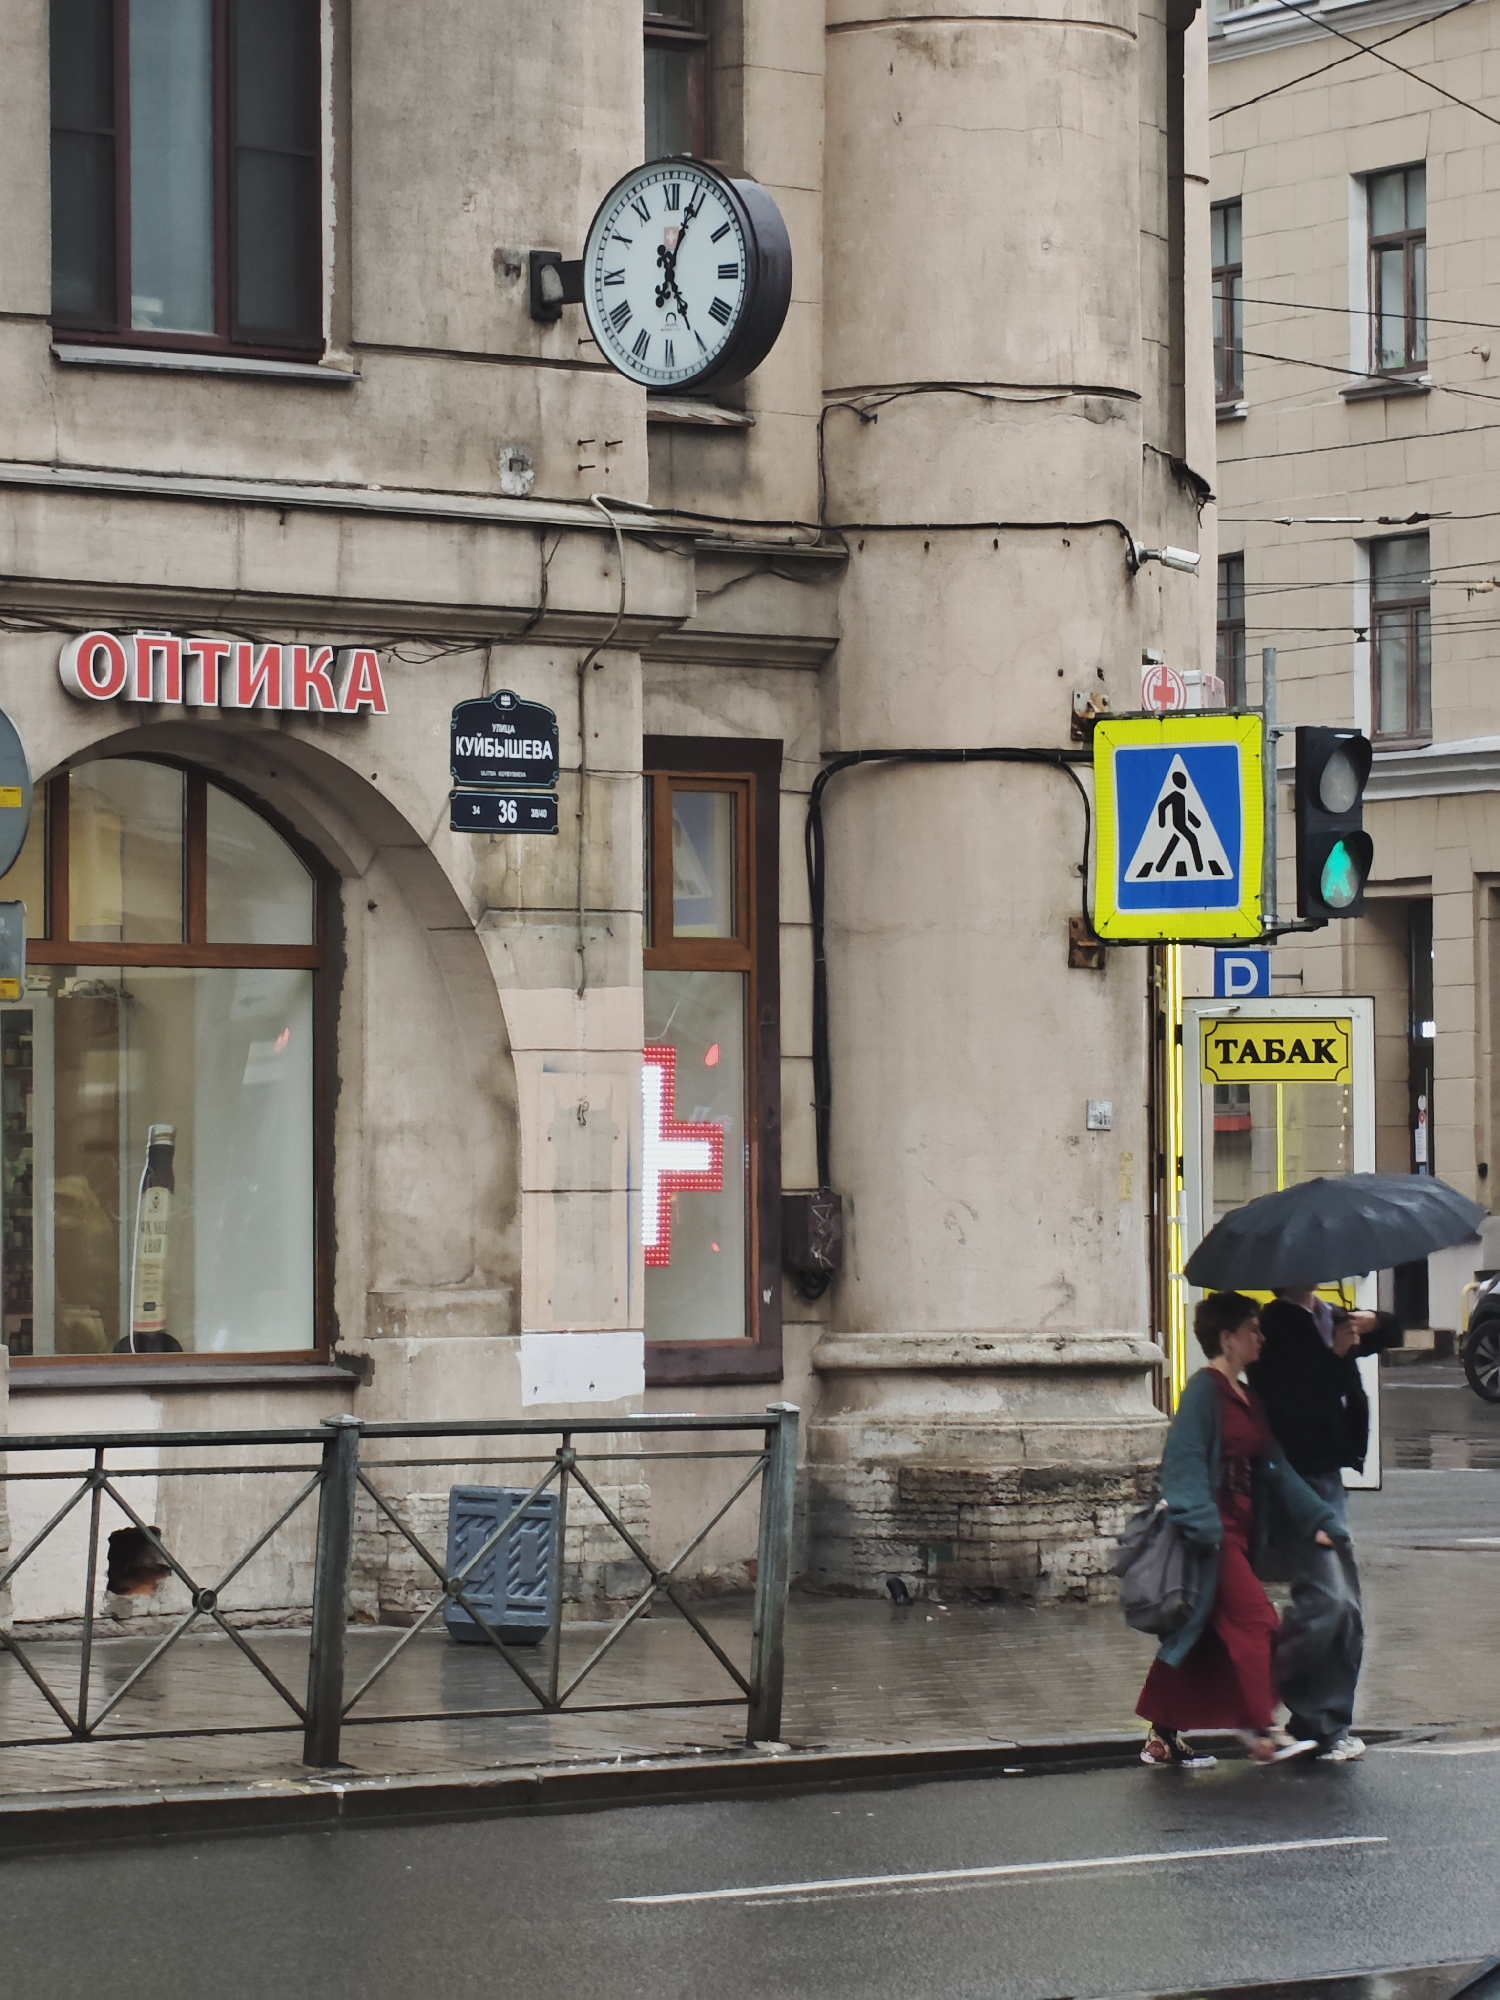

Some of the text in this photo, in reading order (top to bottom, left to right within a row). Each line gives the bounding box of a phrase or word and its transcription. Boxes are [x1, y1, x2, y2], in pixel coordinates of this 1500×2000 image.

[663, 183, 681, 211] XII
[611, 228, 633, 250] X
[710, 221, 731, 244] II
[717, 263, 739, 279] III
[72, 630, 390, 715] ОПТИКА
[492, 723, 516, 735] УЛИЦА
[455, 732, 554, 760] КУЙБЫШЕВА
[472, 799, 548, 824] 34 36 38/40
[1214, 1038, 1339, 1064] ТАБАК
